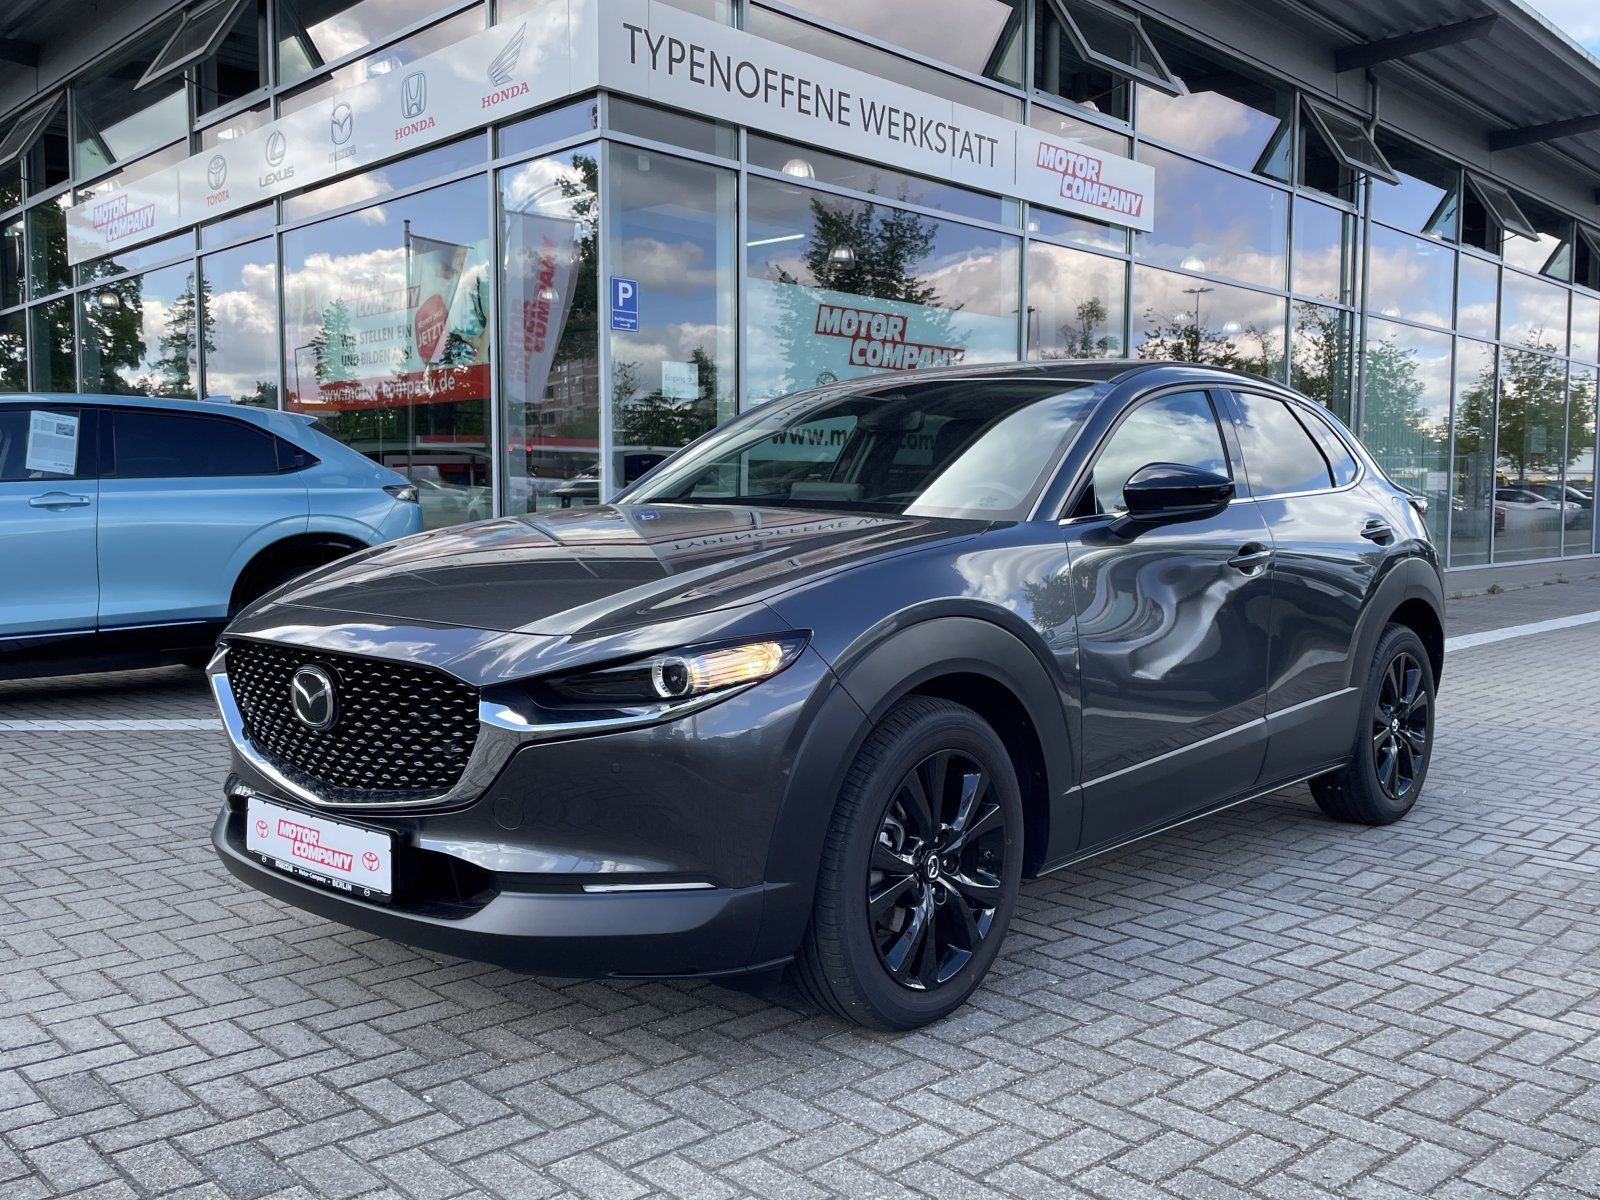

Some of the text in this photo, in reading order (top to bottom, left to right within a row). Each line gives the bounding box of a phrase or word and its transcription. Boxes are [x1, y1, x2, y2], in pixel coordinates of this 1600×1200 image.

[481, 81, 530, 109] HONDA
[622, 22, 999, 168] TYPENOFFENE WERKSTATT
[394, 116, 436, 141] HONDA
[1038, 142, 1100, 181] MOTOR
[259, 165, 295, 188] LEXUS
[206, 189, 230, 207] TOYOTA
[1061, 174, 1142, 216] COMPANY
[95, 196, 127, 227] MOTOR
[107, 205, 155, 241] COMPANY
[618, 281, 633, 307] P
[360, 326, 394, 345] STELLEN
[397, 324, 412, 339] EIN
[817, 305, 904, 342] MOTOR
[361, 349, 390, 365] BILDEN
[279, 820, 319, 845] MOTOR
[293, 840, 353, 872] COMPANY
[332, 879, 353, 892] BERLIN
